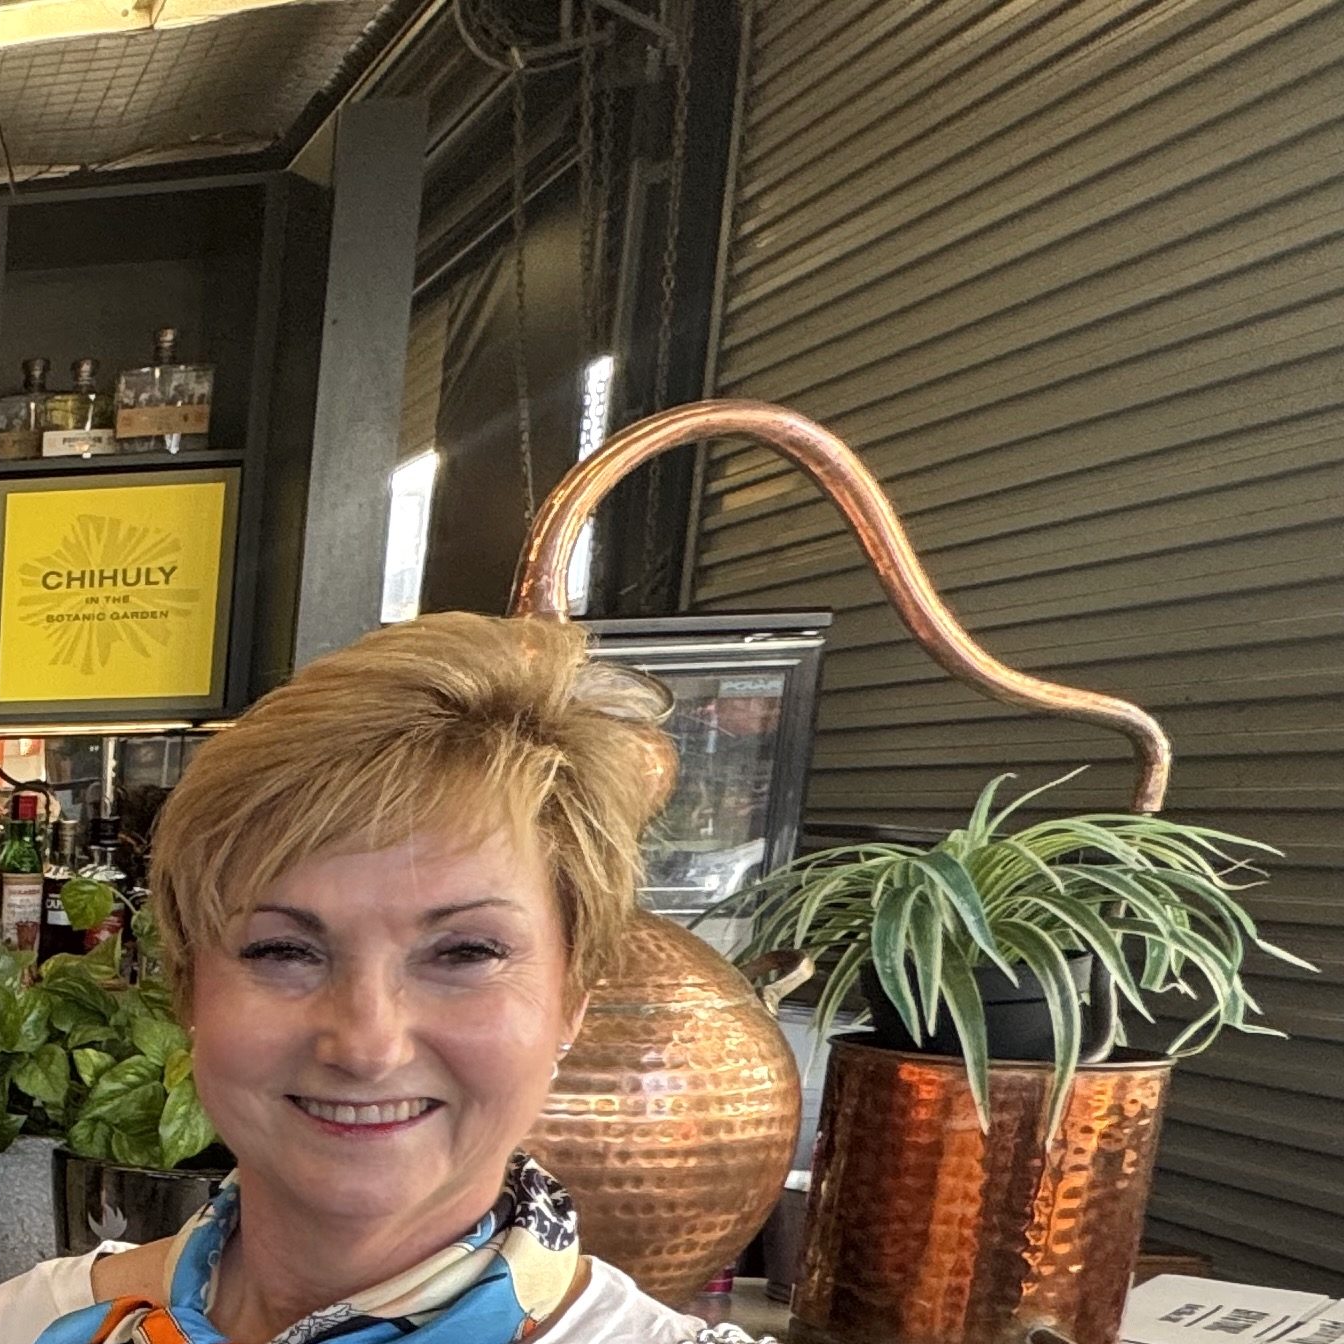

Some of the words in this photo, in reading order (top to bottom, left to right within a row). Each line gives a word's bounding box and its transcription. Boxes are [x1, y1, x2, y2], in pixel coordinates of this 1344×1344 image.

[41, 565, 178, 590] CHIHULY
[85, 595, 100, 604] IN
[104, 594, 130, 604] THE
[46, 611, 106, 623] BOTANIC
[110, 609, 170, 621] GARDEN
